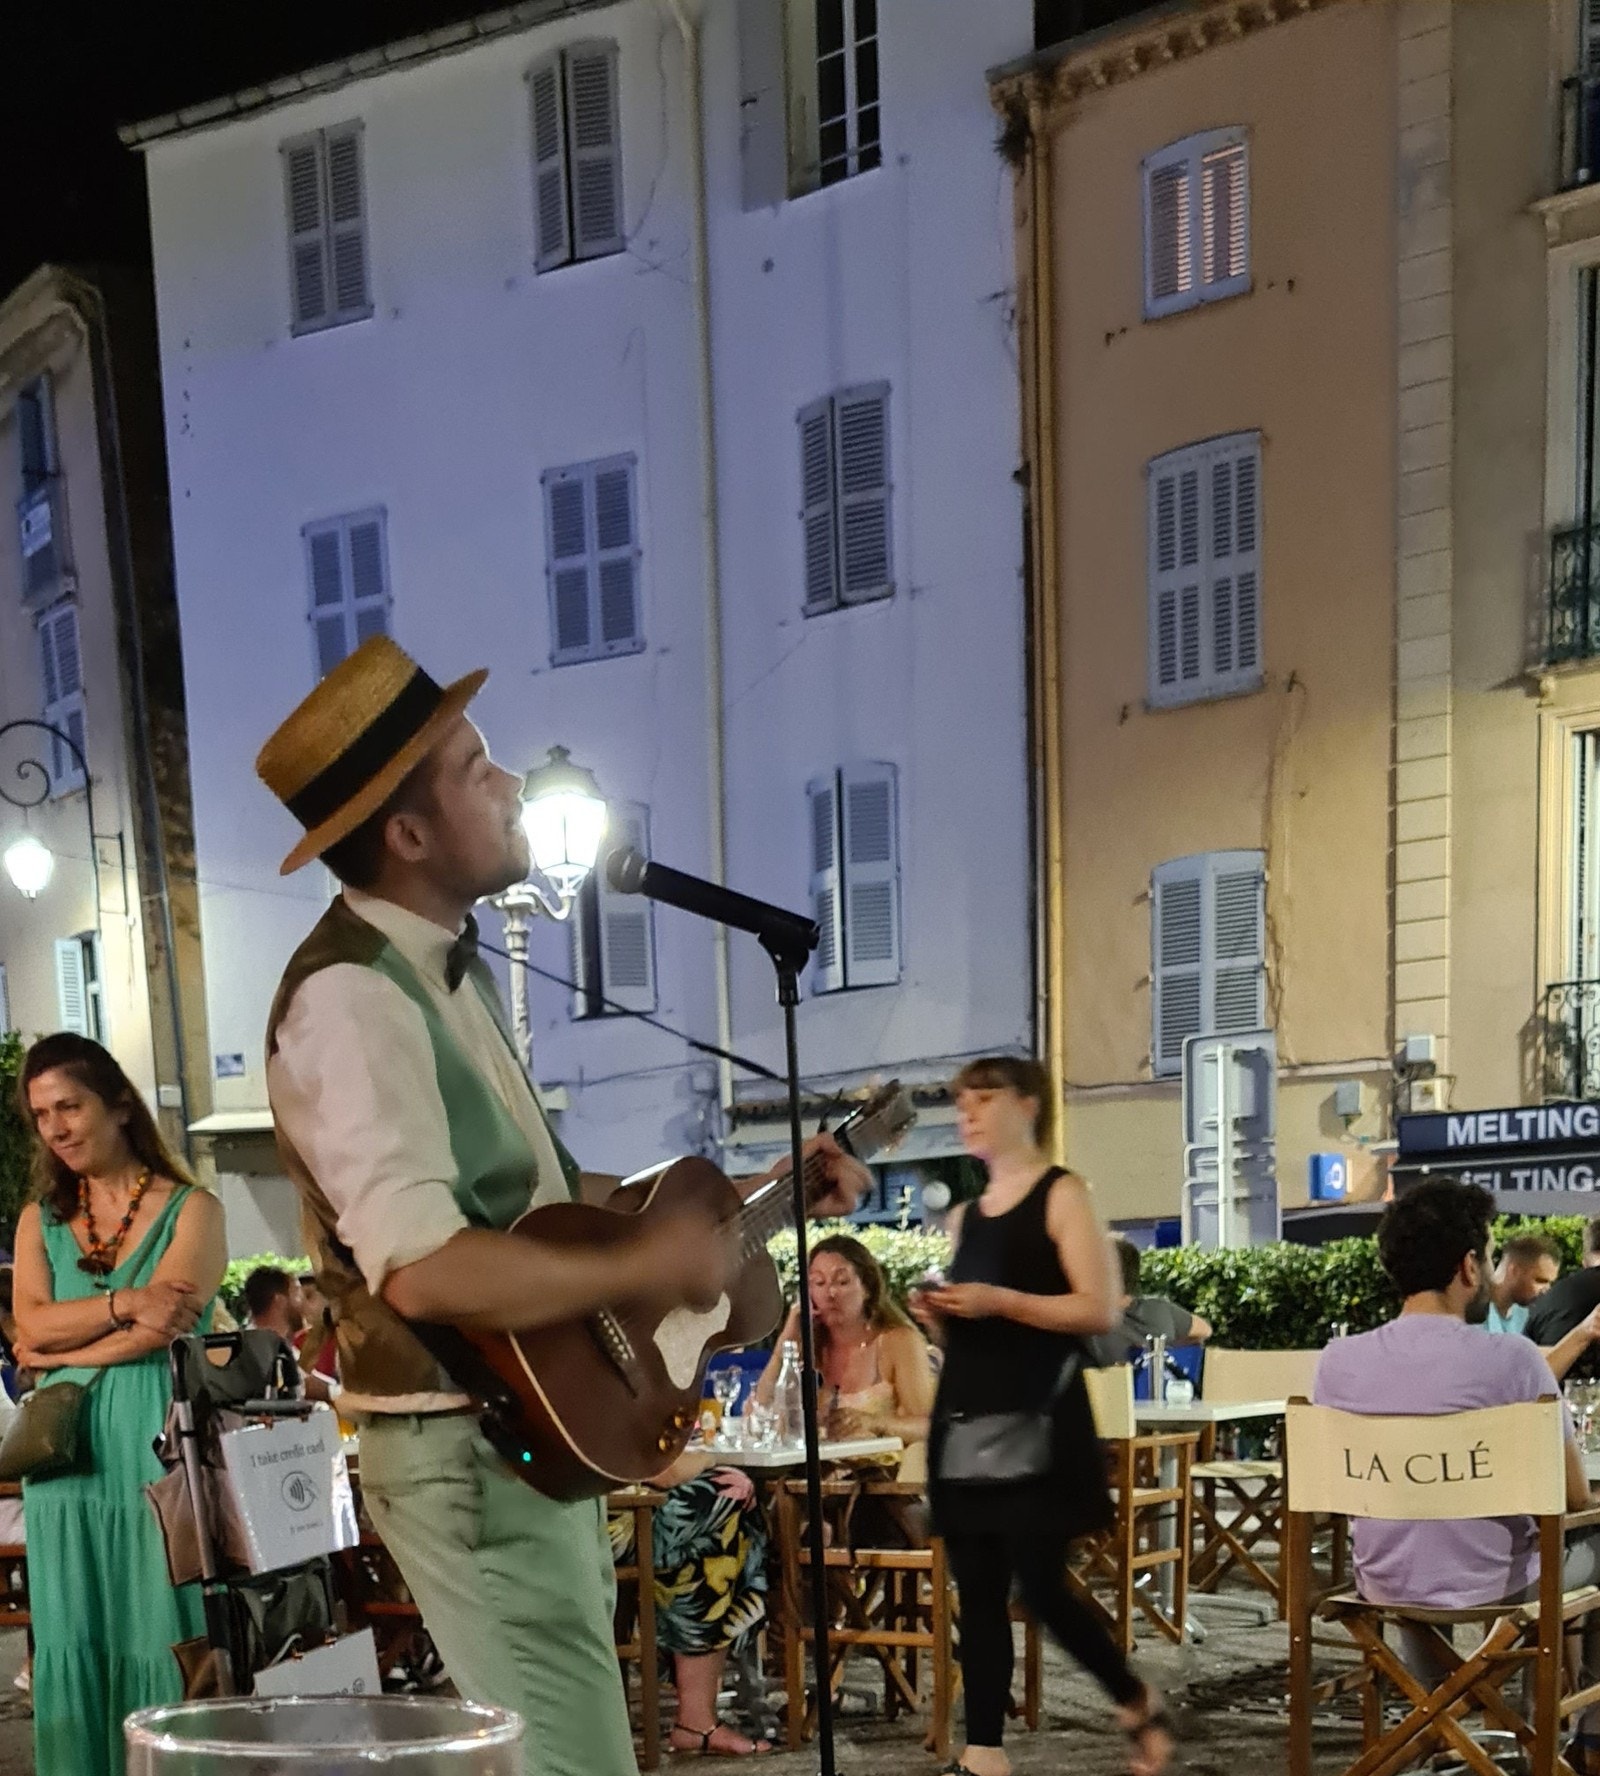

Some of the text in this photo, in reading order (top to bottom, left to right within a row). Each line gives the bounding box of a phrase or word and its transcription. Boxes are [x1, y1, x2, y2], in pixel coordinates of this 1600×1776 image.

[1447, 1105, 1600, 1147] MELTING
[1343, 1440, 1494, 1485] LA CLÉ
